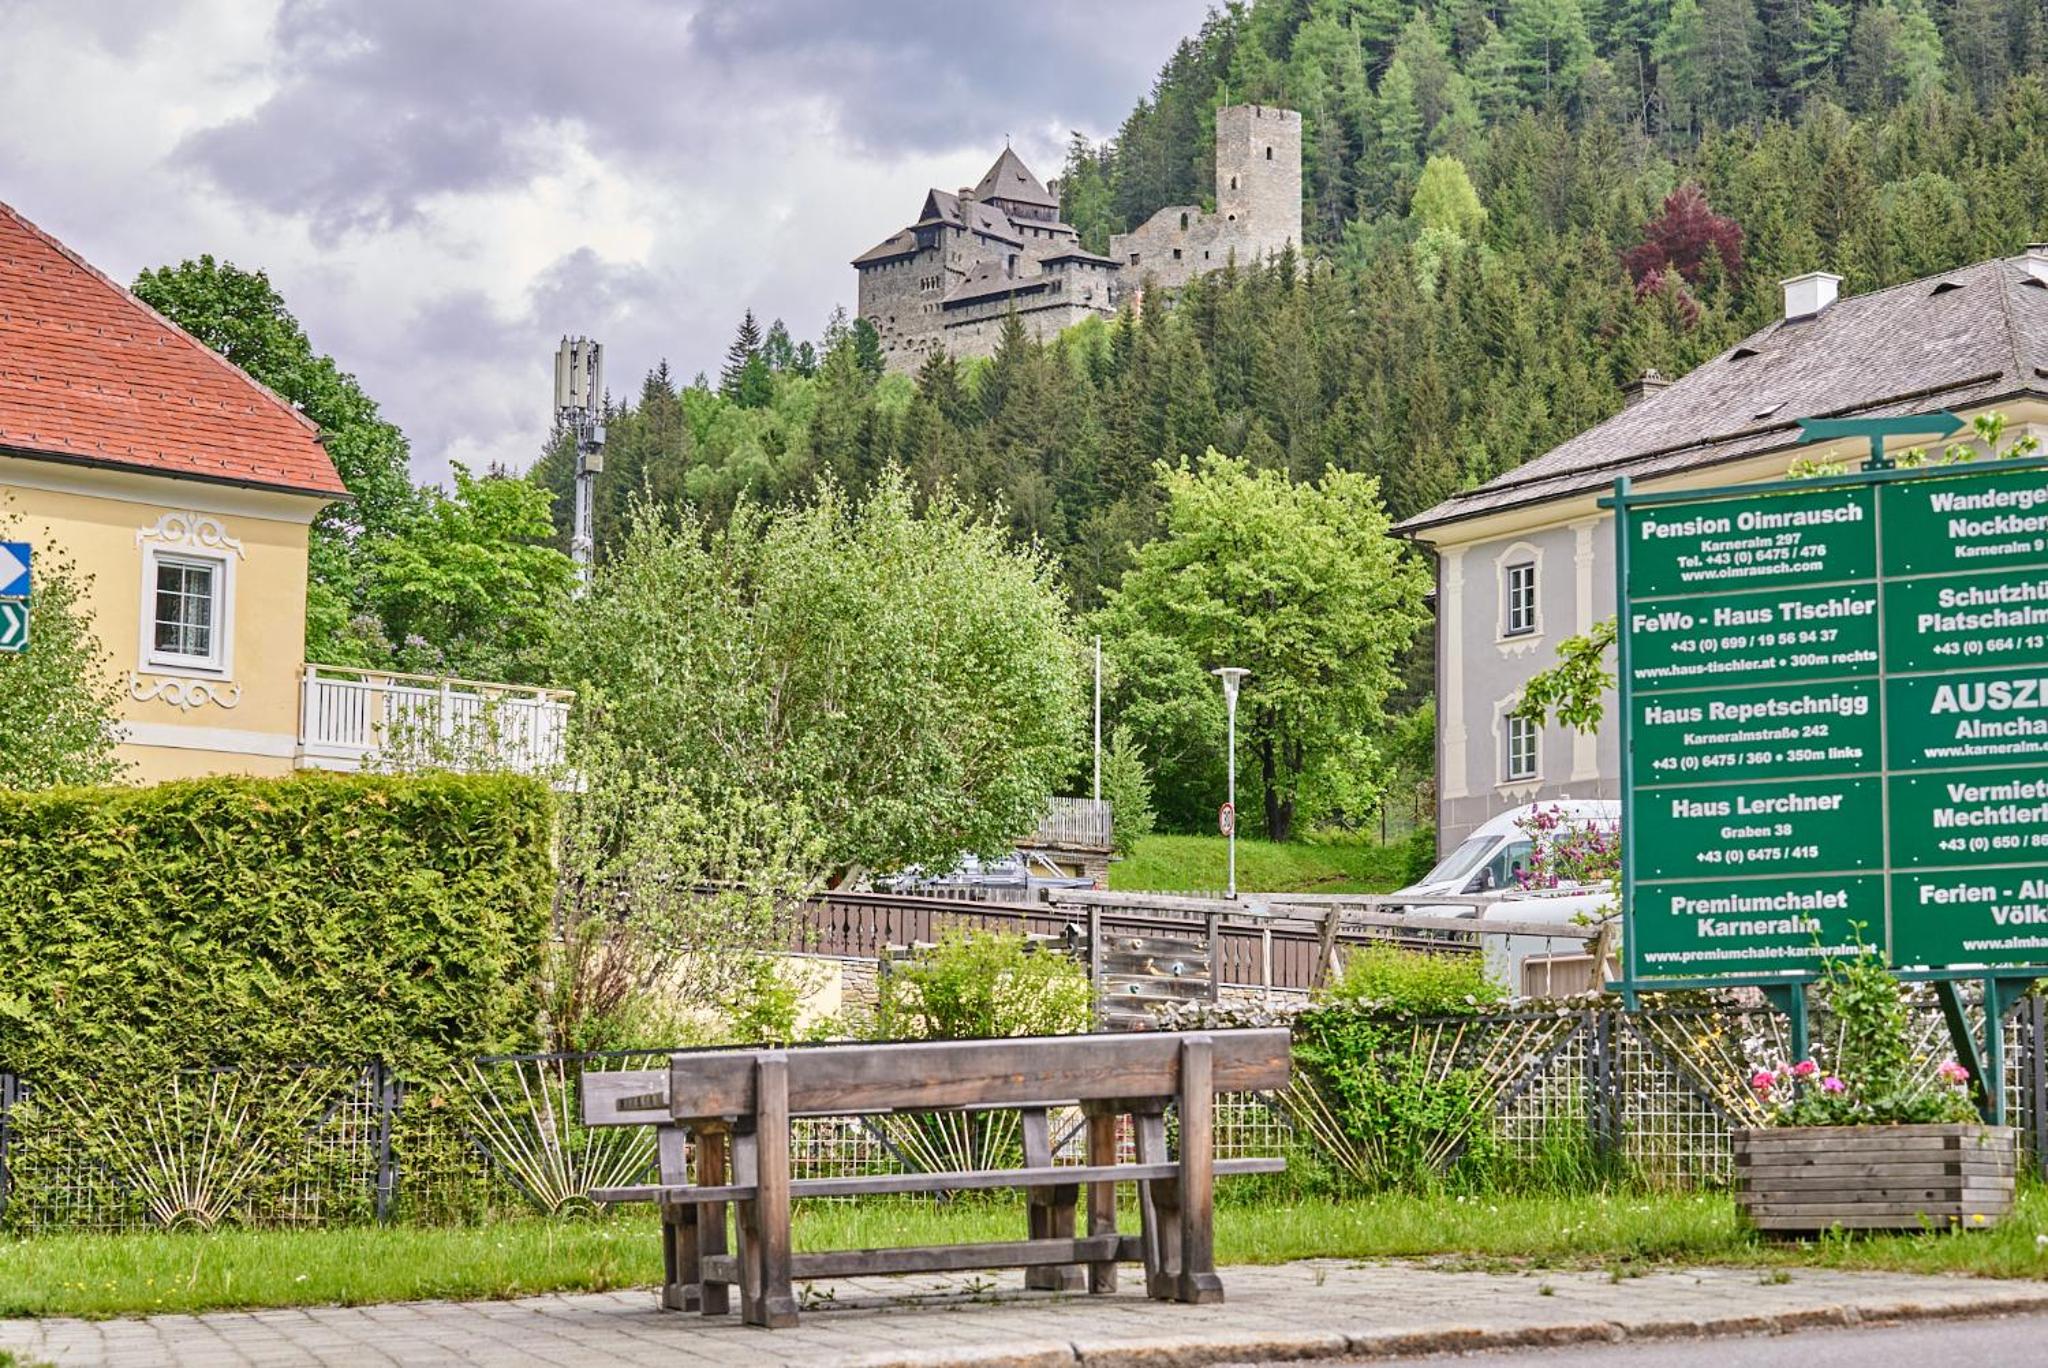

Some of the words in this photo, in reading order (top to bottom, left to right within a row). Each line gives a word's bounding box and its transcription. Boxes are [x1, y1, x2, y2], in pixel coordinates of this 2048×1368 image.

[1930, 485, 2048, 512] Wanderge
[1642, 517, 1730, 539] Pension
[1737, 503, 1862, 530] Oimrausch
[1949, 514, 2048, 538] Nockber
[1701, 537, 1772, 552] Karneralm
[1776, 533, 1801, 546] 297
[1955, 541, 2031, 557] Karneralm
[2034, 539, 2044, 551] 9
[1677, 555, 1702, 568] Tel.
[1706, 553, 1731, 564] +43
[1734, 551, 1752, 565] (0)
[1756, 548, 1790, 561] 6475
[1792, 547, 1797, 558] /
[1800, 544, 1826, 557] 476
[1681, 560, 1824, 582] www.oimrausch.com
[1633, 612, 1693, 633] FeWo
[1714, 608, 1773, 626] Haus
[1779, 598, 1876, 621] Tischler
[1671, 640, 1696, 652] +43
[1699, 639, 1718, 653] (0)
[1721, 637, 1747, 649] 699
[1750, 636, 1754, 646] /
[1758, 634, 1775, 646] 19
[1778, 632, 1796, 645] 56
[1799, 631, 1817, 643] 94
[1820, 629, 1837, 641] 37
[1933, 642, 1960, 654] +43
[1963, 641, 1983, 656] (0)
[1986, 638, 2014, 651] 664
[2017, 638, 2022, 649] /
[2025, 636, 2043, 648] 13
[1635, 657, 1776, 678] www.haus-tischler.at
[1791, 654, 1829, 666] 300m
[1832, 650, 1877, 663] rechts
[1645, 707, 1702, 725] Haus
[1709, 694, 1868, 722] Repetschnigg
[1684, 727, 1799, 745] Karneralmstraße
[1802, 725, 1828, 737] 242
[1652, 758, 1677, 769] +43
[1681, 756, 1699, 770] (0)
[1702, 754, 1736, 767] 6475
[1738, 754, 1743, 764] /
[1747, 752, 1772, 764] 360
[1787, 749, 1825, 762] 350m
[1828, 747, 1862, 759] links
[1947, 779, 2048, 802] Vermiet
[1672, 799, 1730, 817] Haus
[1737, 794, 1842, 814] Lerchner
[1721, 826, 1771, 839] Graben
[1775, 824, 1792, 836] 38
[1697, 851, 1722, 863] +43
[1725, 850, 1744, 864] (0)
[1747, 848, 1781, 861] 6475
[1784, 848, 1789, 858] /
[1792, 846, 1818, 858] 415
[1939, 838, 1966, 850] +43
[1969, 837, 1989, 852] (0)
[1992, 835, 2020, 848] 650
[2023, 835, 2028, 846] /
[1671, 889, 1848, 915] Premiumchalet
[1920, 884, 1996, 904] Ferien
[2018, 880, 2048, 899] Al
[1991, 904, 2048, 925] Völk
